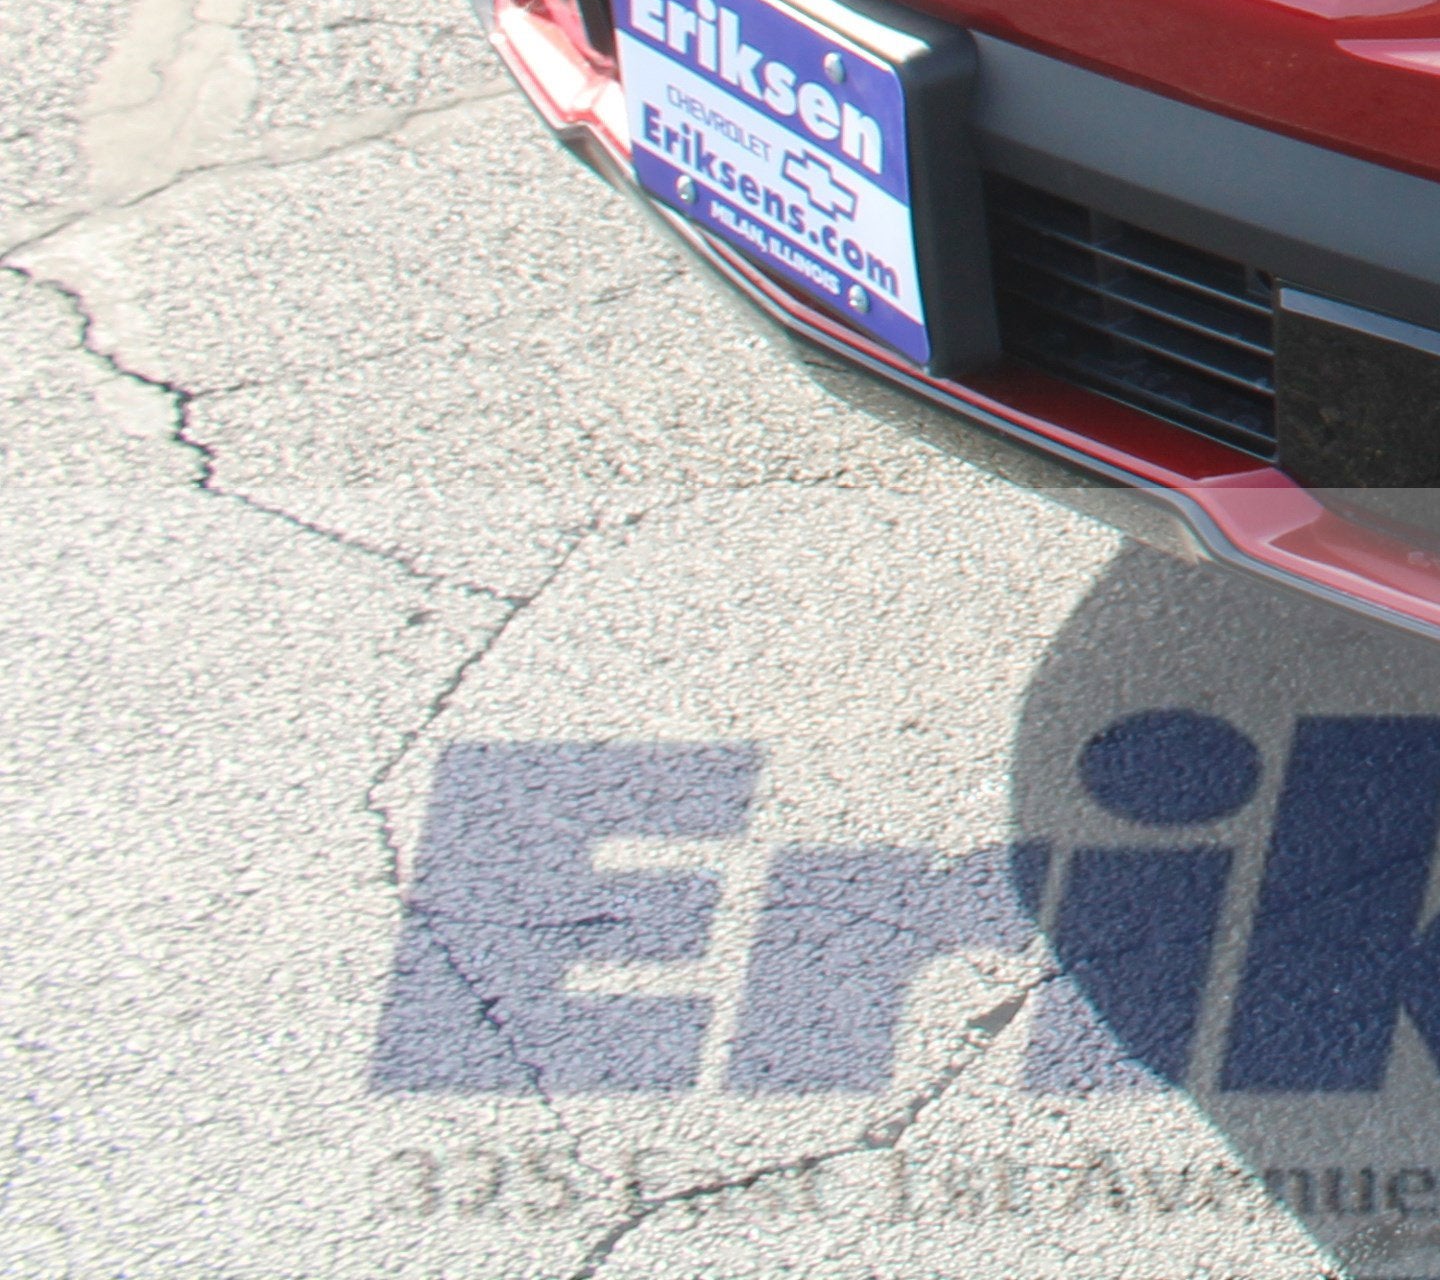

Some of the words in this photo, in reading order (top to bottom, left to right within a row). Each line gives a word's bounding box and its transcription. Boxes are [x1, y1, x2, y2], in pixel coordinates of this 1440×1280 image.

[666, 83, 773, 164] CHEVROLET
[642, 101, 899, 297] Eriksens.com
[709, 200, 768, 254] MILAN,
[769, 227, 842, 296] ILLINOIS
